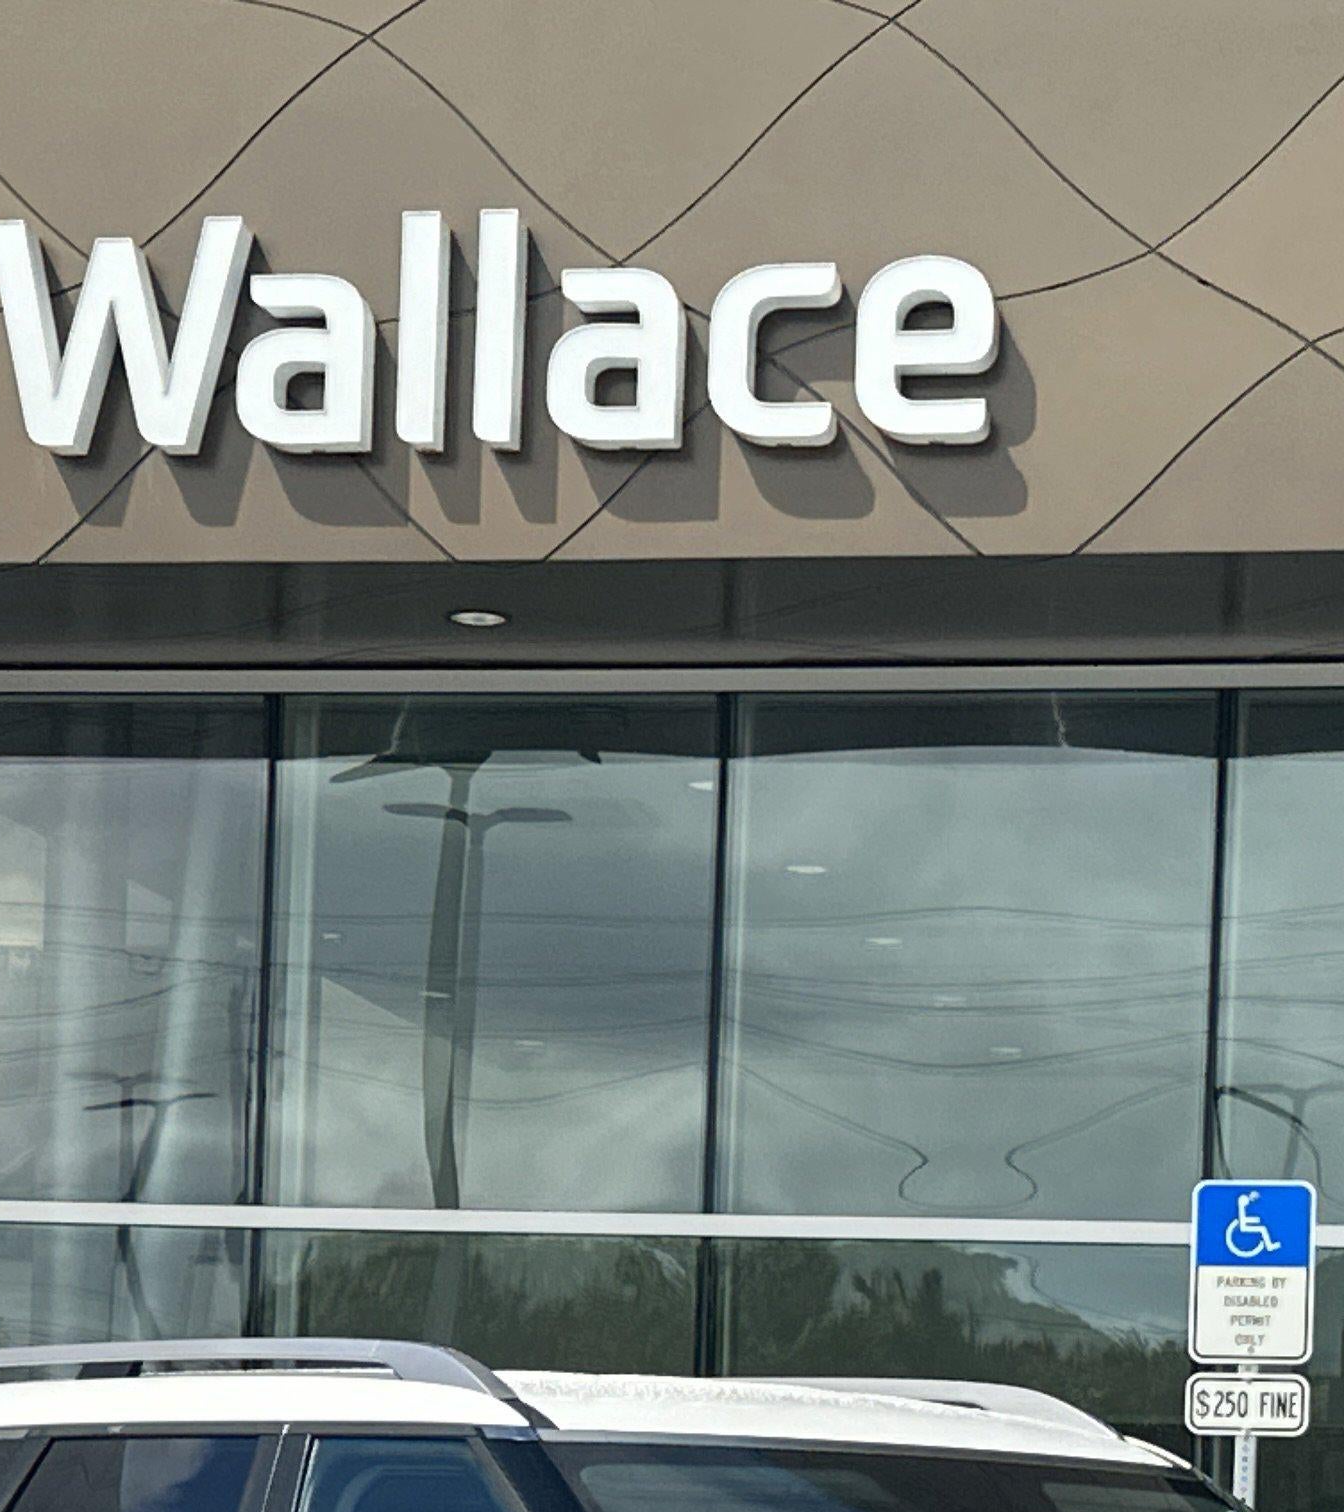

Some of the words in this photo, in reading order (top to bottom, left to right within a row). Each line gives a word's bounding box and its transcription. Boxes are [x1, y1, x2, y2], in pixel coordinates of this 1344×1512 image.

[1223, 1295, 1278, 1308] DISABLED
[1196, 1389, 1248, 1419] $250
[1260, 1392, 1298, 1418] FINE
